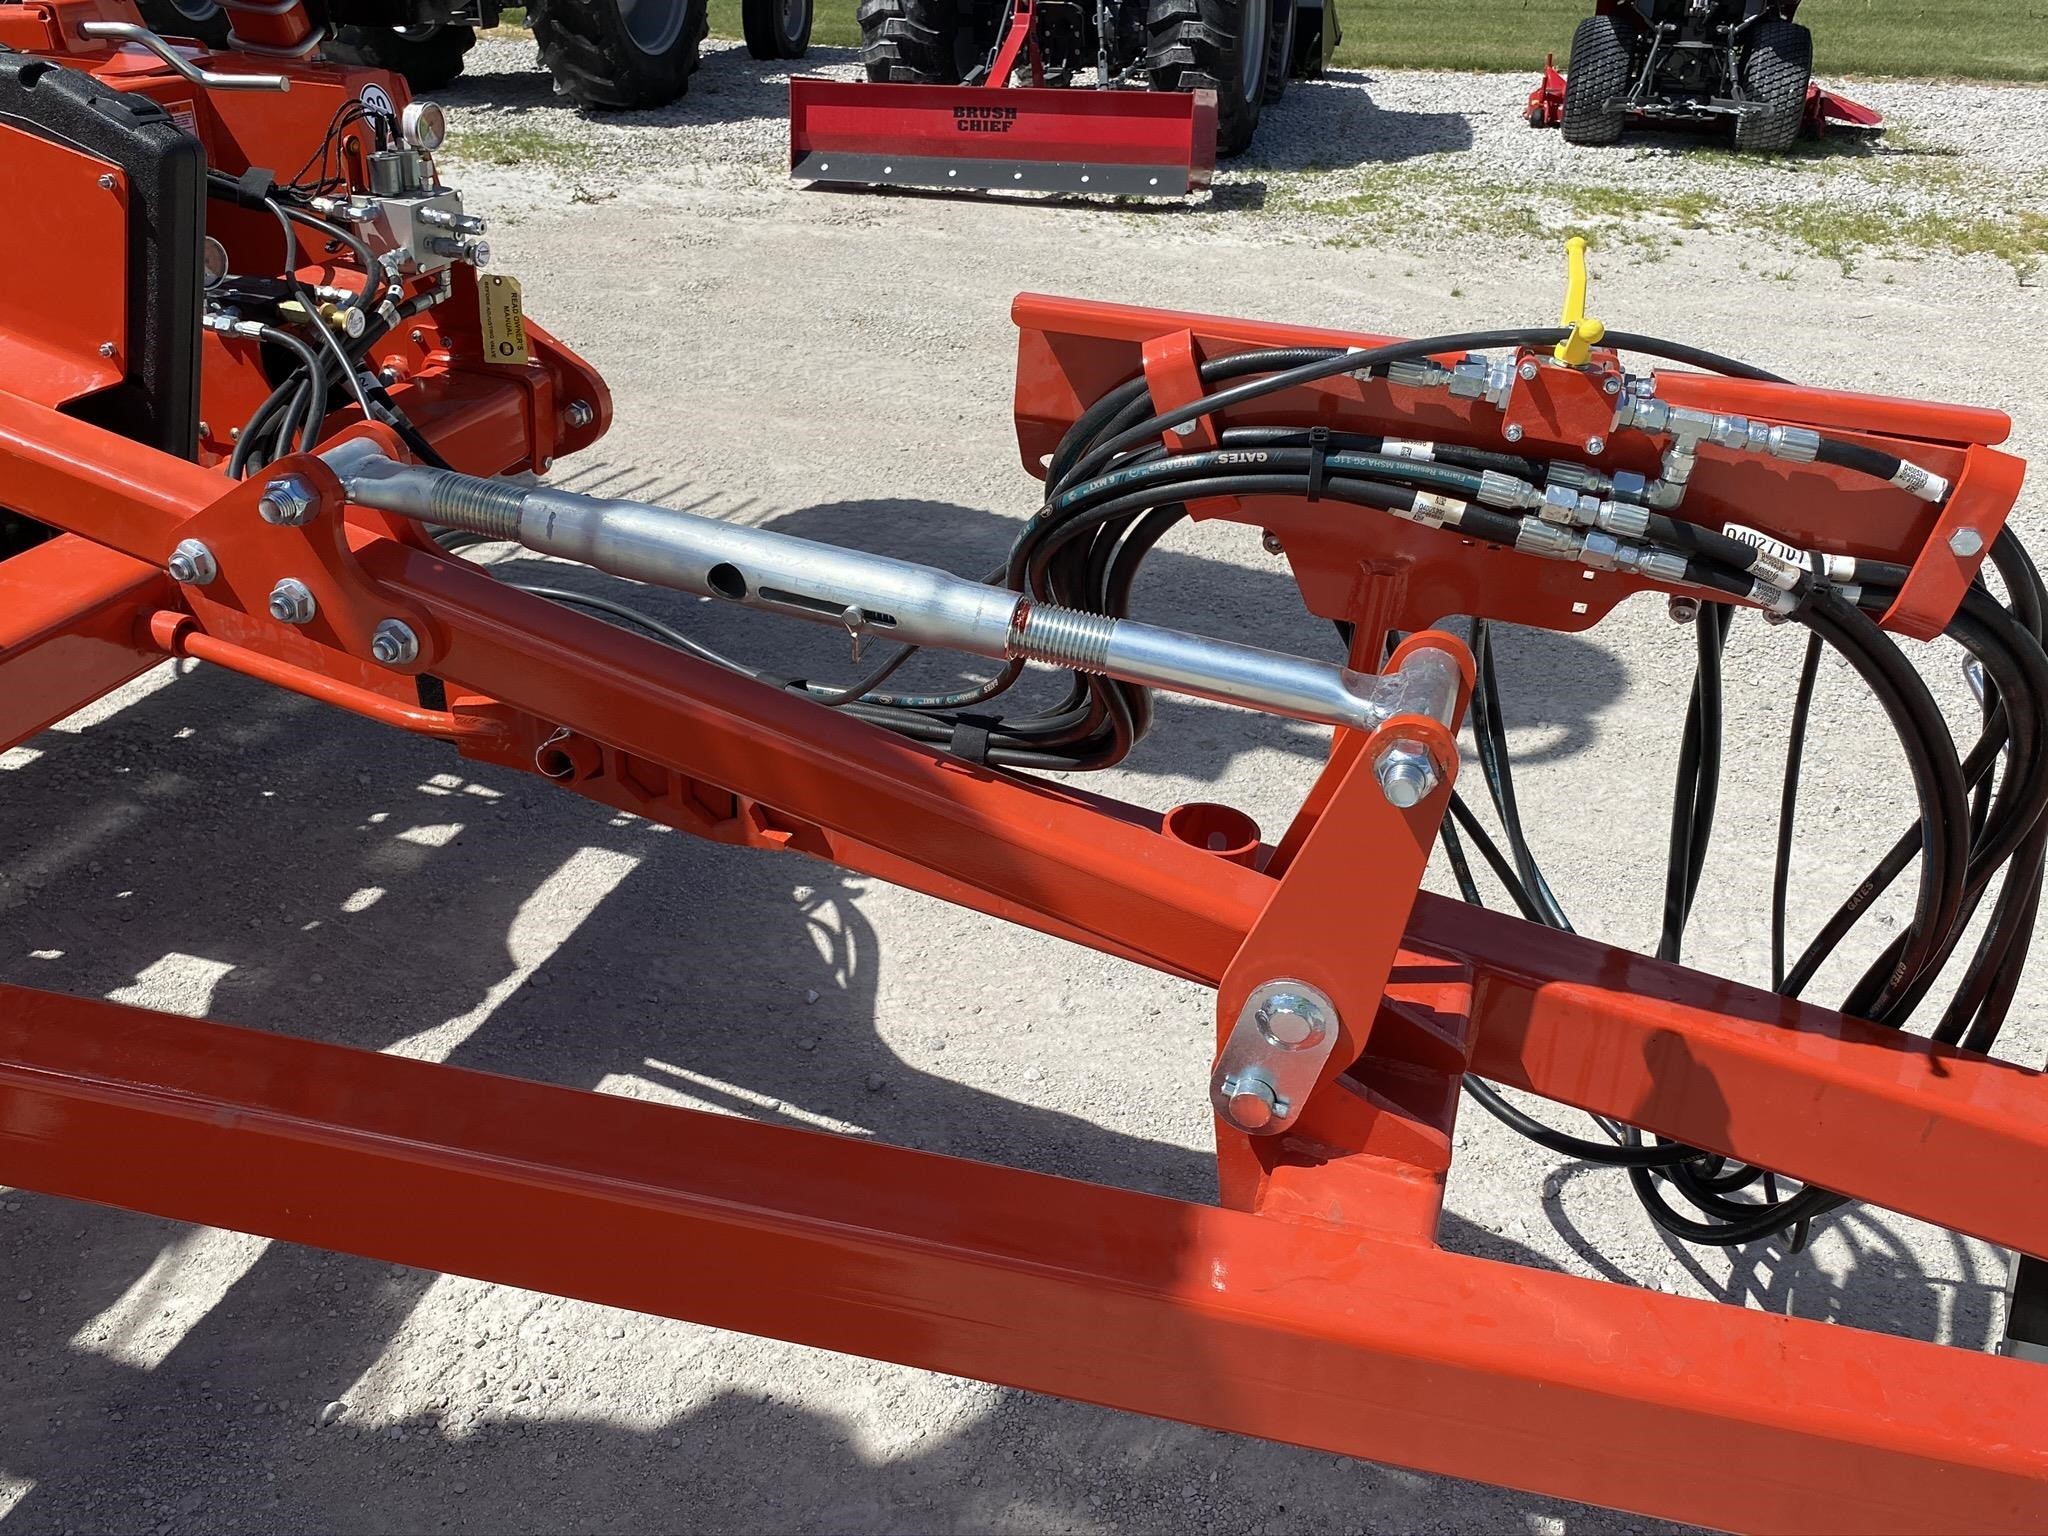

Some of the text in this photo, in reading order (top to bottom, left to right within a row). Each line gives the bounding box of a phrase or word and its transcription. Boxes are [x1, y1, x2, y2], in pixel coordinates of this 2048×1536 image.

[953, 106, 1017, 119] BRUSH
[957, 119, 1013, 132] CHIEF
[504, 306, 513, 337] MANUAL
[511, 292, 524, 351] READ OWNER'S
[1217, 452, 1268, 463] GATES
[1368, 459, 1394, 470] MSHA
[1397, 463, 1437, 476] Resistant
[1439, 470, 1465, 482] Flame
[1847, 880, 1874, 911] GATES
[1890, 961, 1907, 989] GATES
